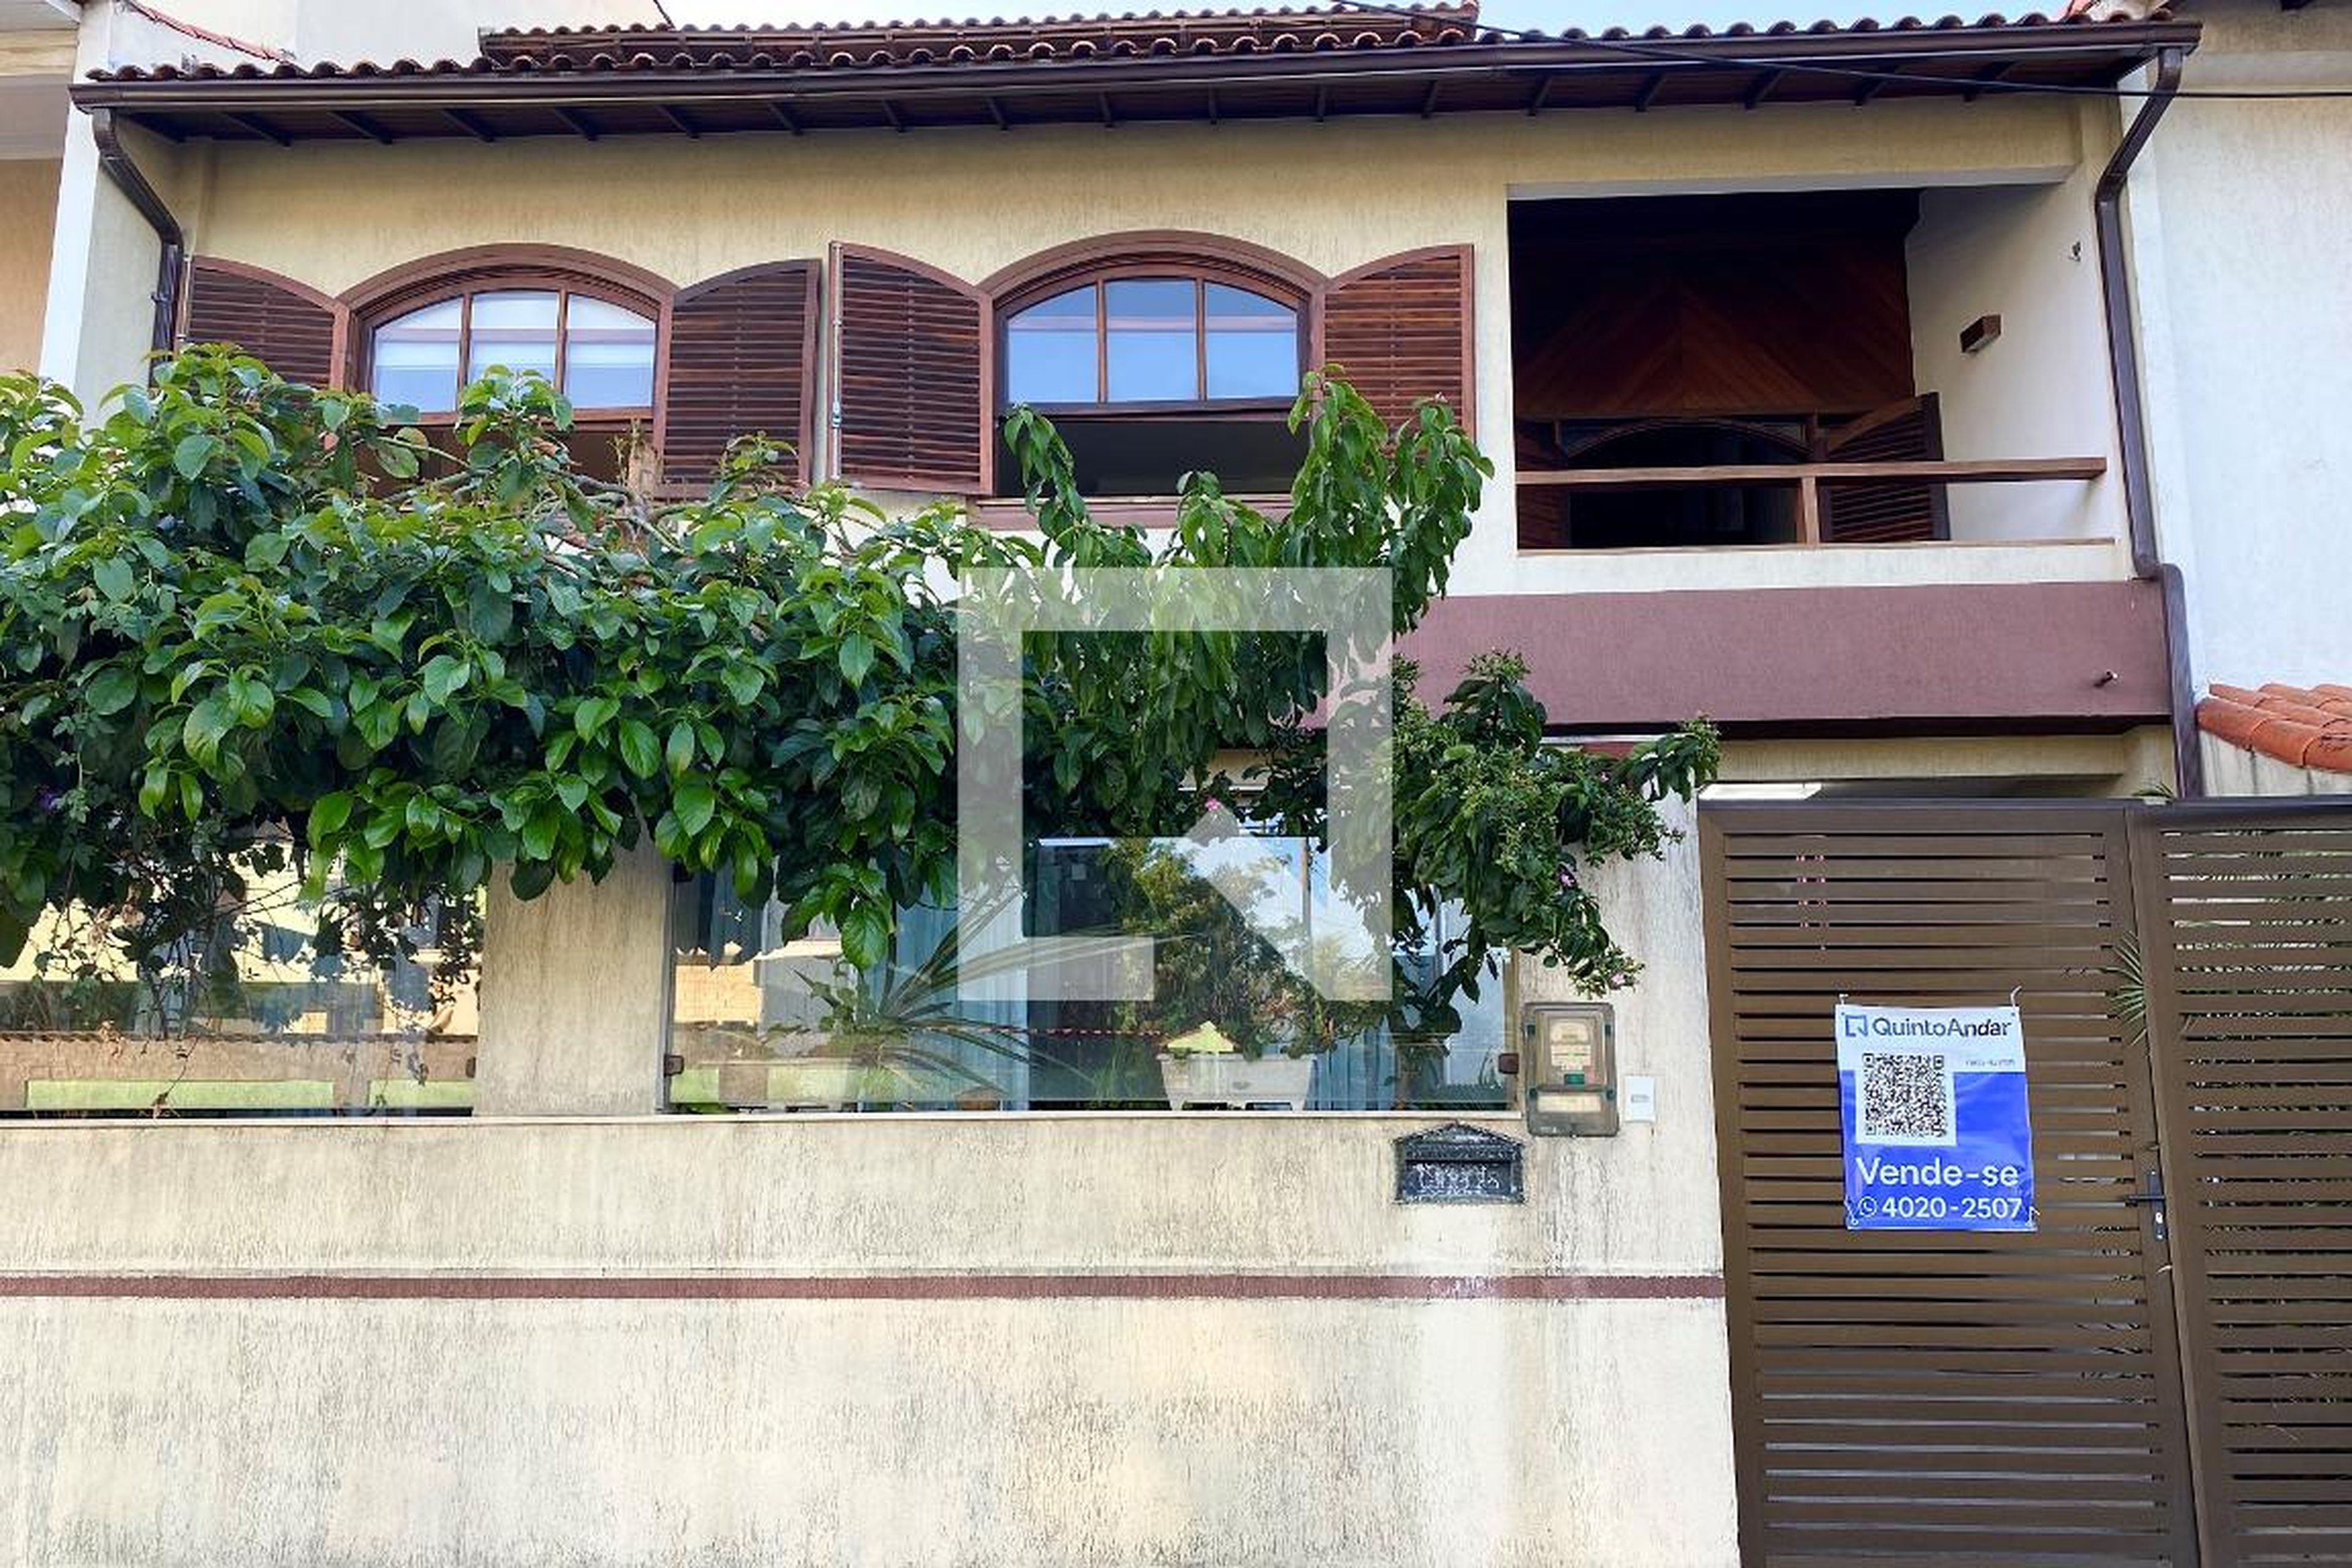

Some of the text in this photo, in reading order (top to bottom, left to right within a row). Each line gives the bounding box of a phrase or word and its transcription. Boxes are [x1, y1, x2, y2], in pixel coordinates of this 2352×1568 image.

[1872, 1017, 2011, 1036] QuintoAndar
[1856, 1157, 2019, 1186] Vende-se
[1882, 1196, 2022, 1218] 4020-2507
